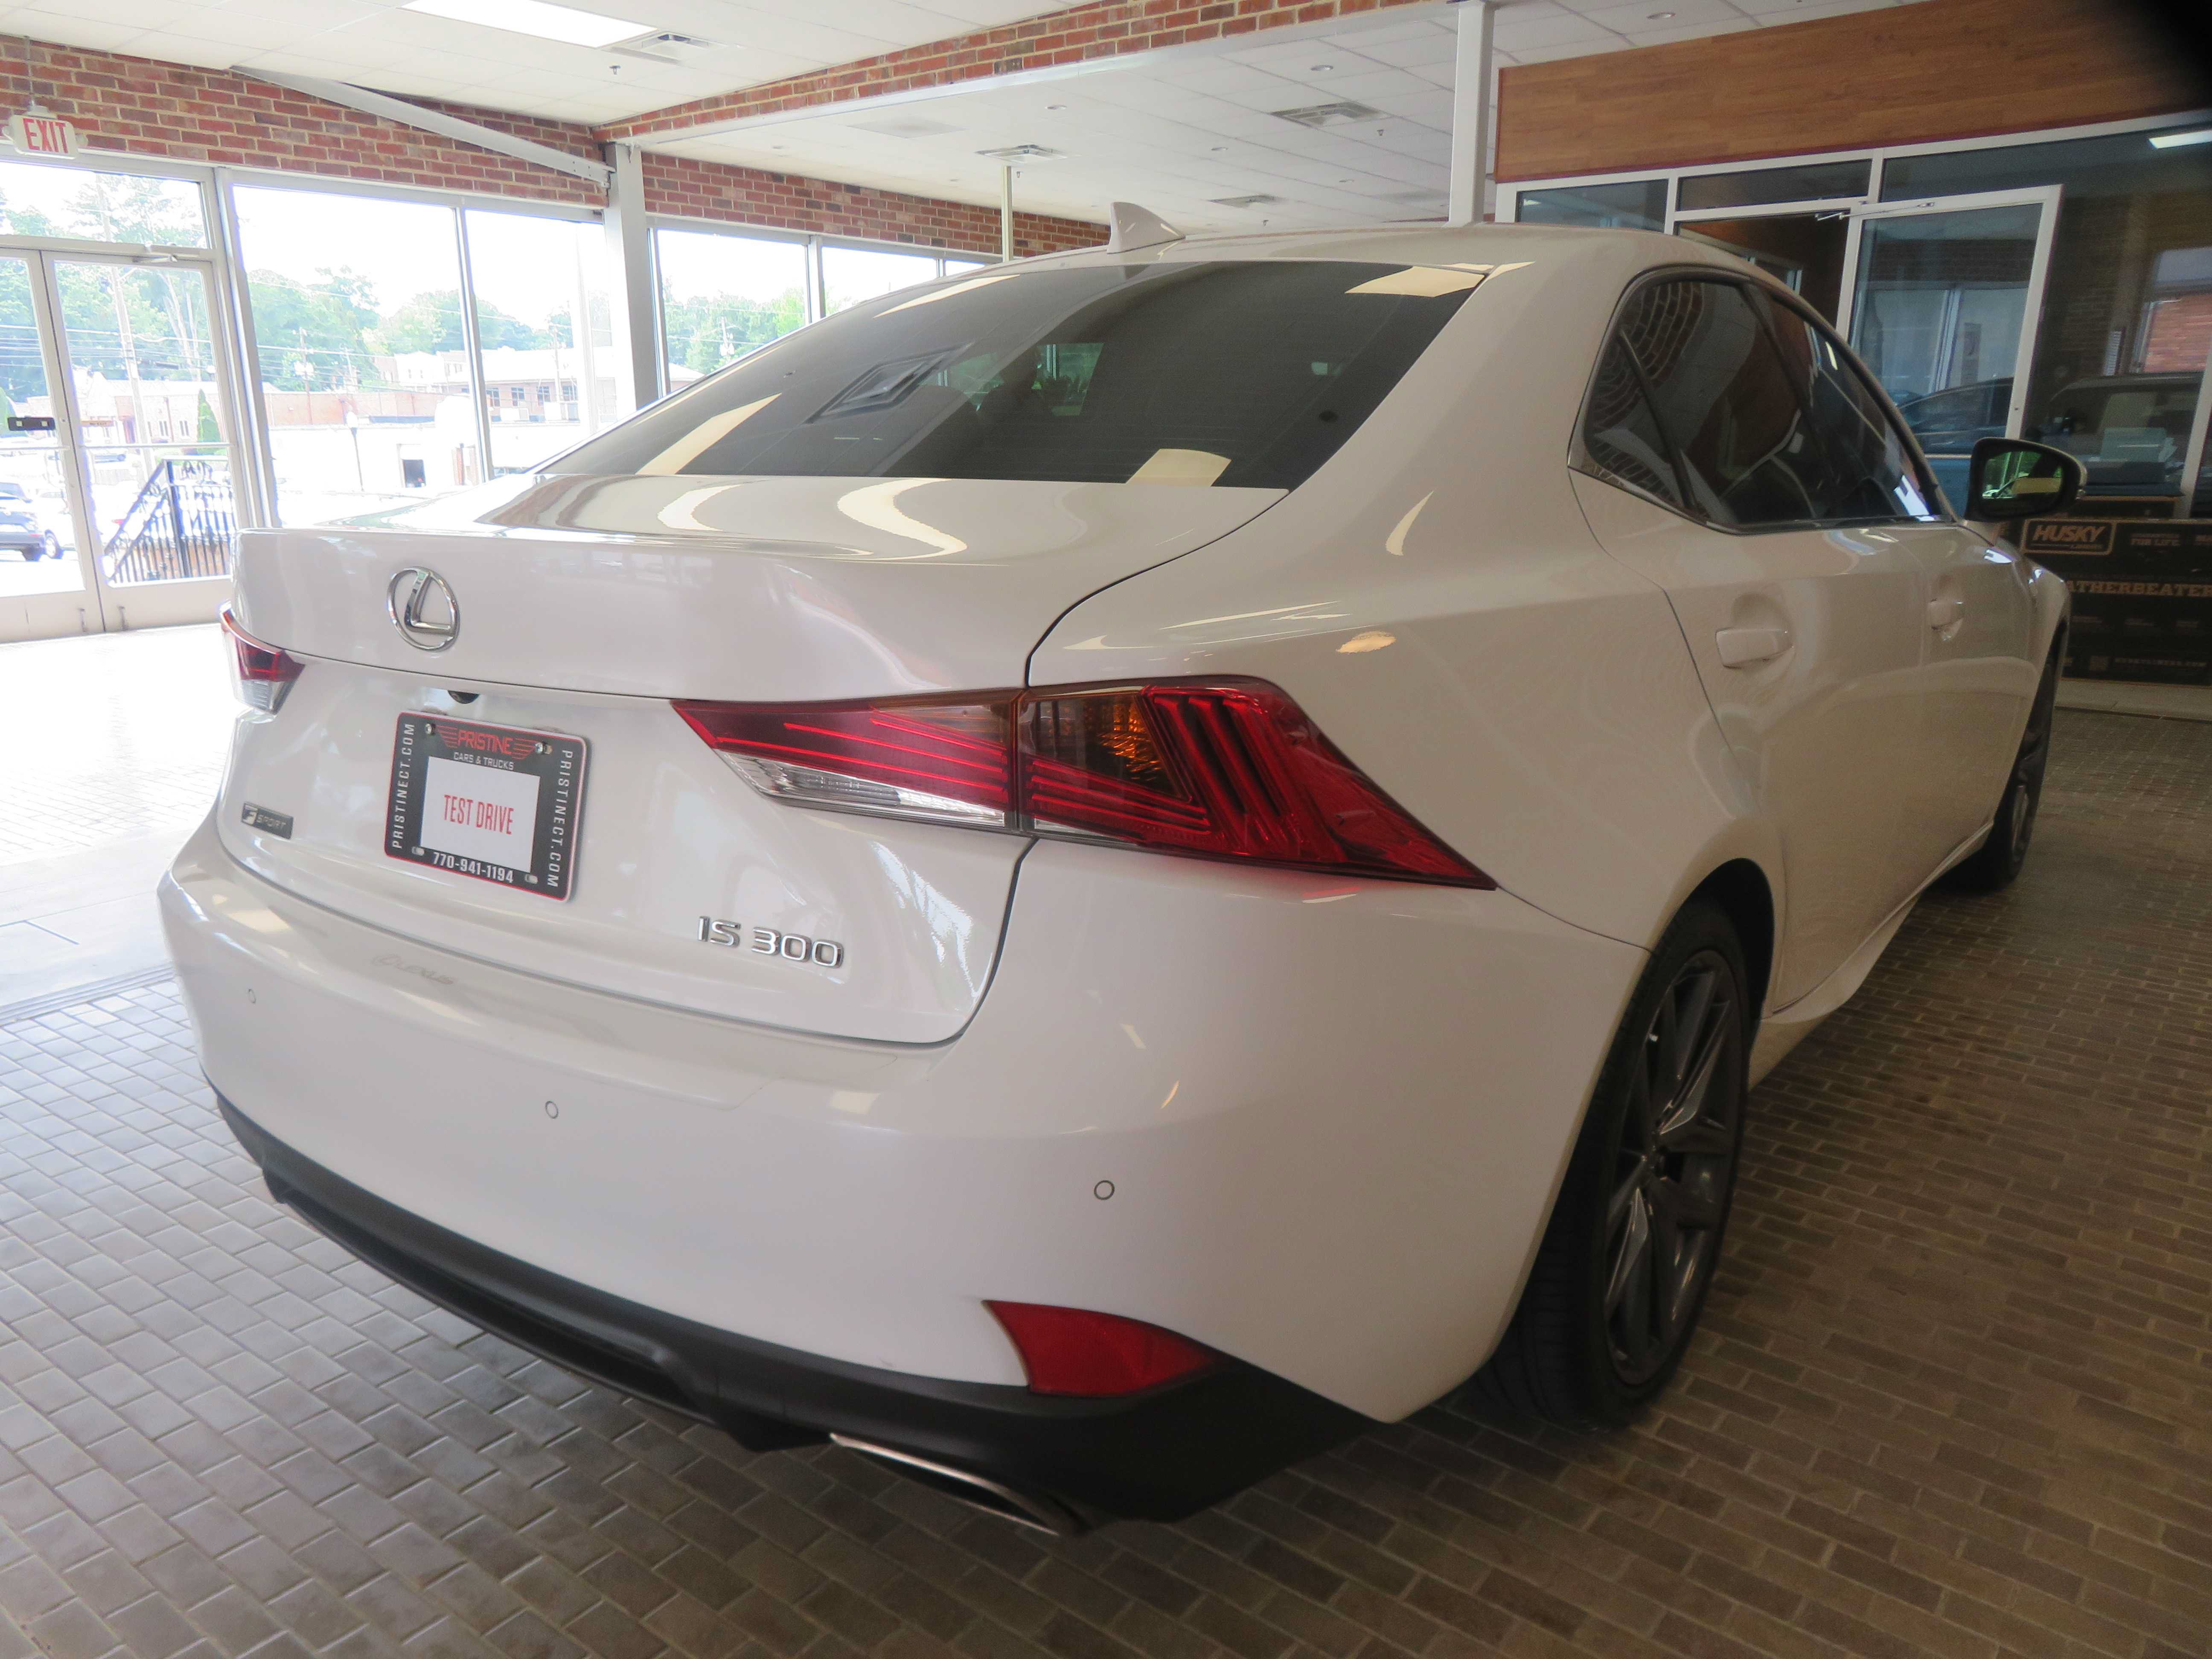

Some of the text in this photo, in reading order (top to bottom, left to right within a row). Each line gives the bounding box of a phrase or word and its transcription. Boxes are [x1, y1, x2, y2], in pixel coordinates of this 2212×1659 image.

[23, 118, 69, 154] EXIT
[2032, 525, 2106, 542] HUSKY
[457, 730, 513, 755] PRISTINE
[454, 752, 514, 770] CARS & TRUCKS
[392, 723, 415, 849] PRISTINECT.COM
[444, 795, 514, 835] TEST DRIVE
[547, 750, 573, 887] PRISTINECT.COM
[433, 852, 513, 883] 770-941-1194
[697, 916, 844, 968] IS 300
